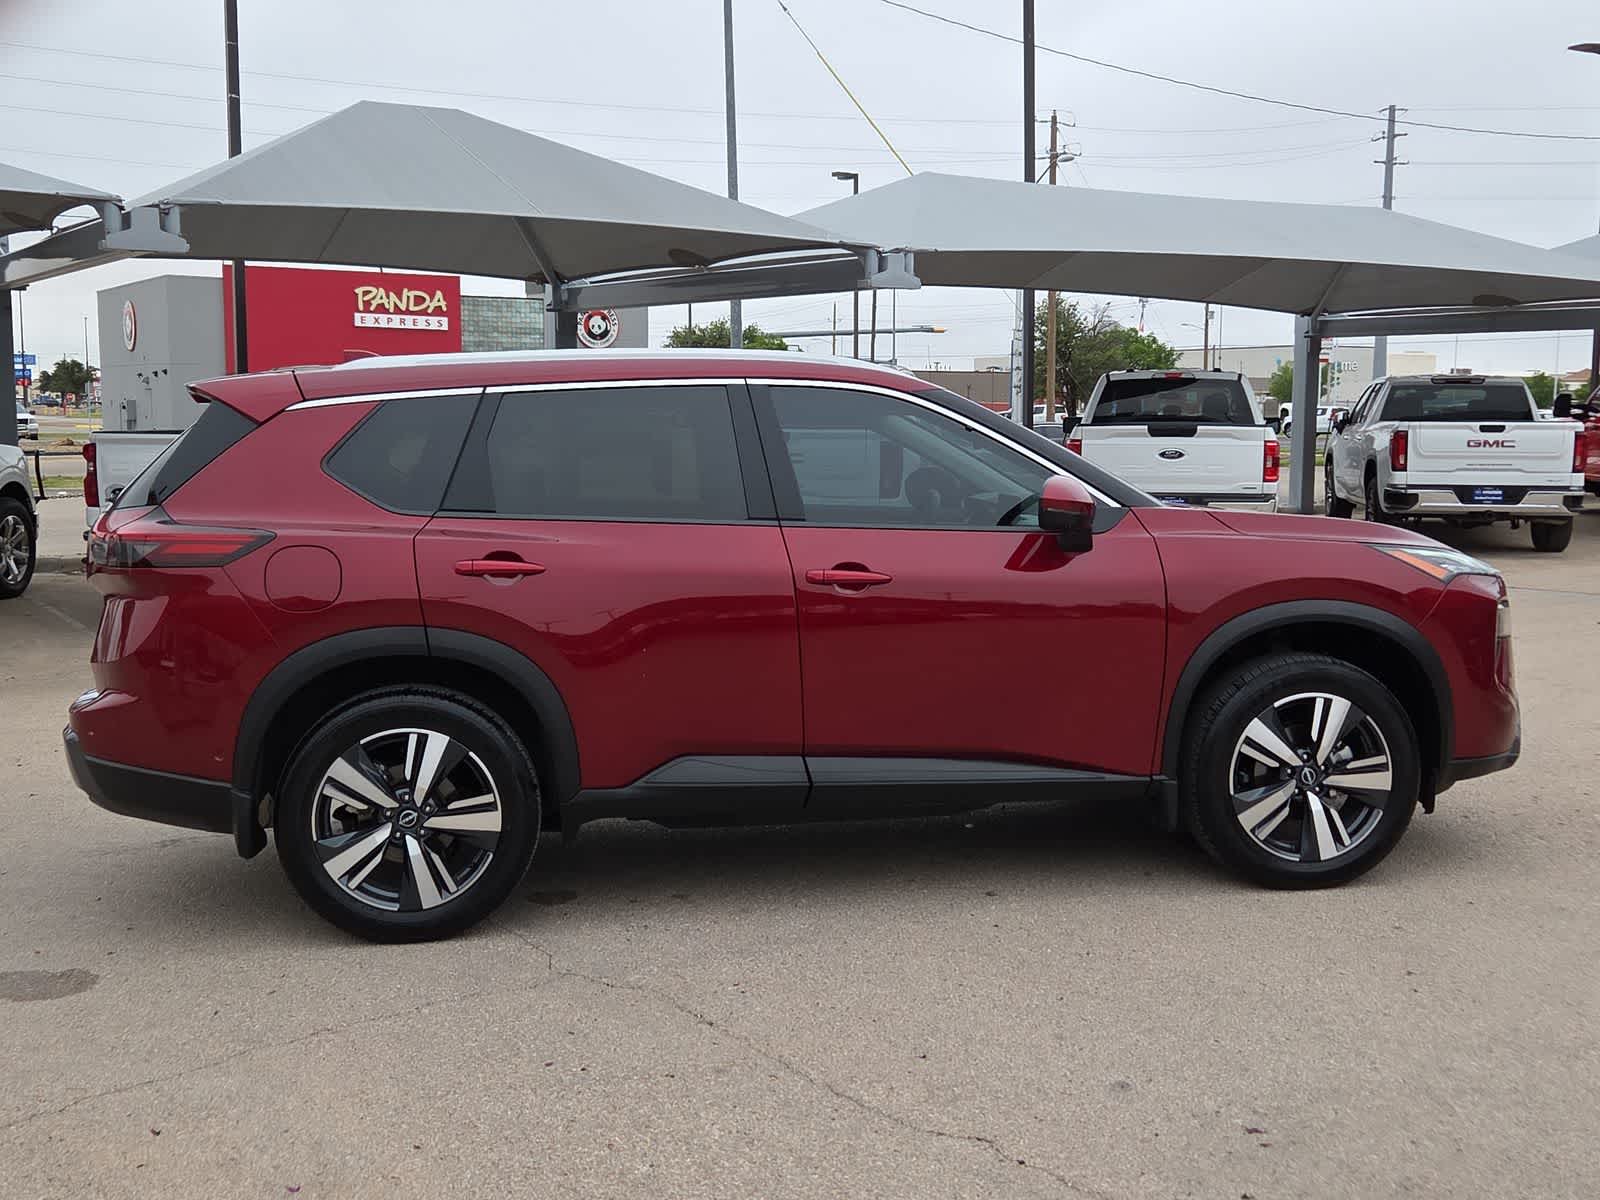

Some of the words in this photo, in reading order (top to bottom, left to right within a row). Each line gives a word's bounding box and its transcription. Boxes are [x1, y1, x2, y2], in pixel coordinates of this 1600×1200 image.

[354, 286, 447, 313] PANDA
[360, 316, 443, 328] EXPRESS
[1466, 439, 1516, 448] GMC
